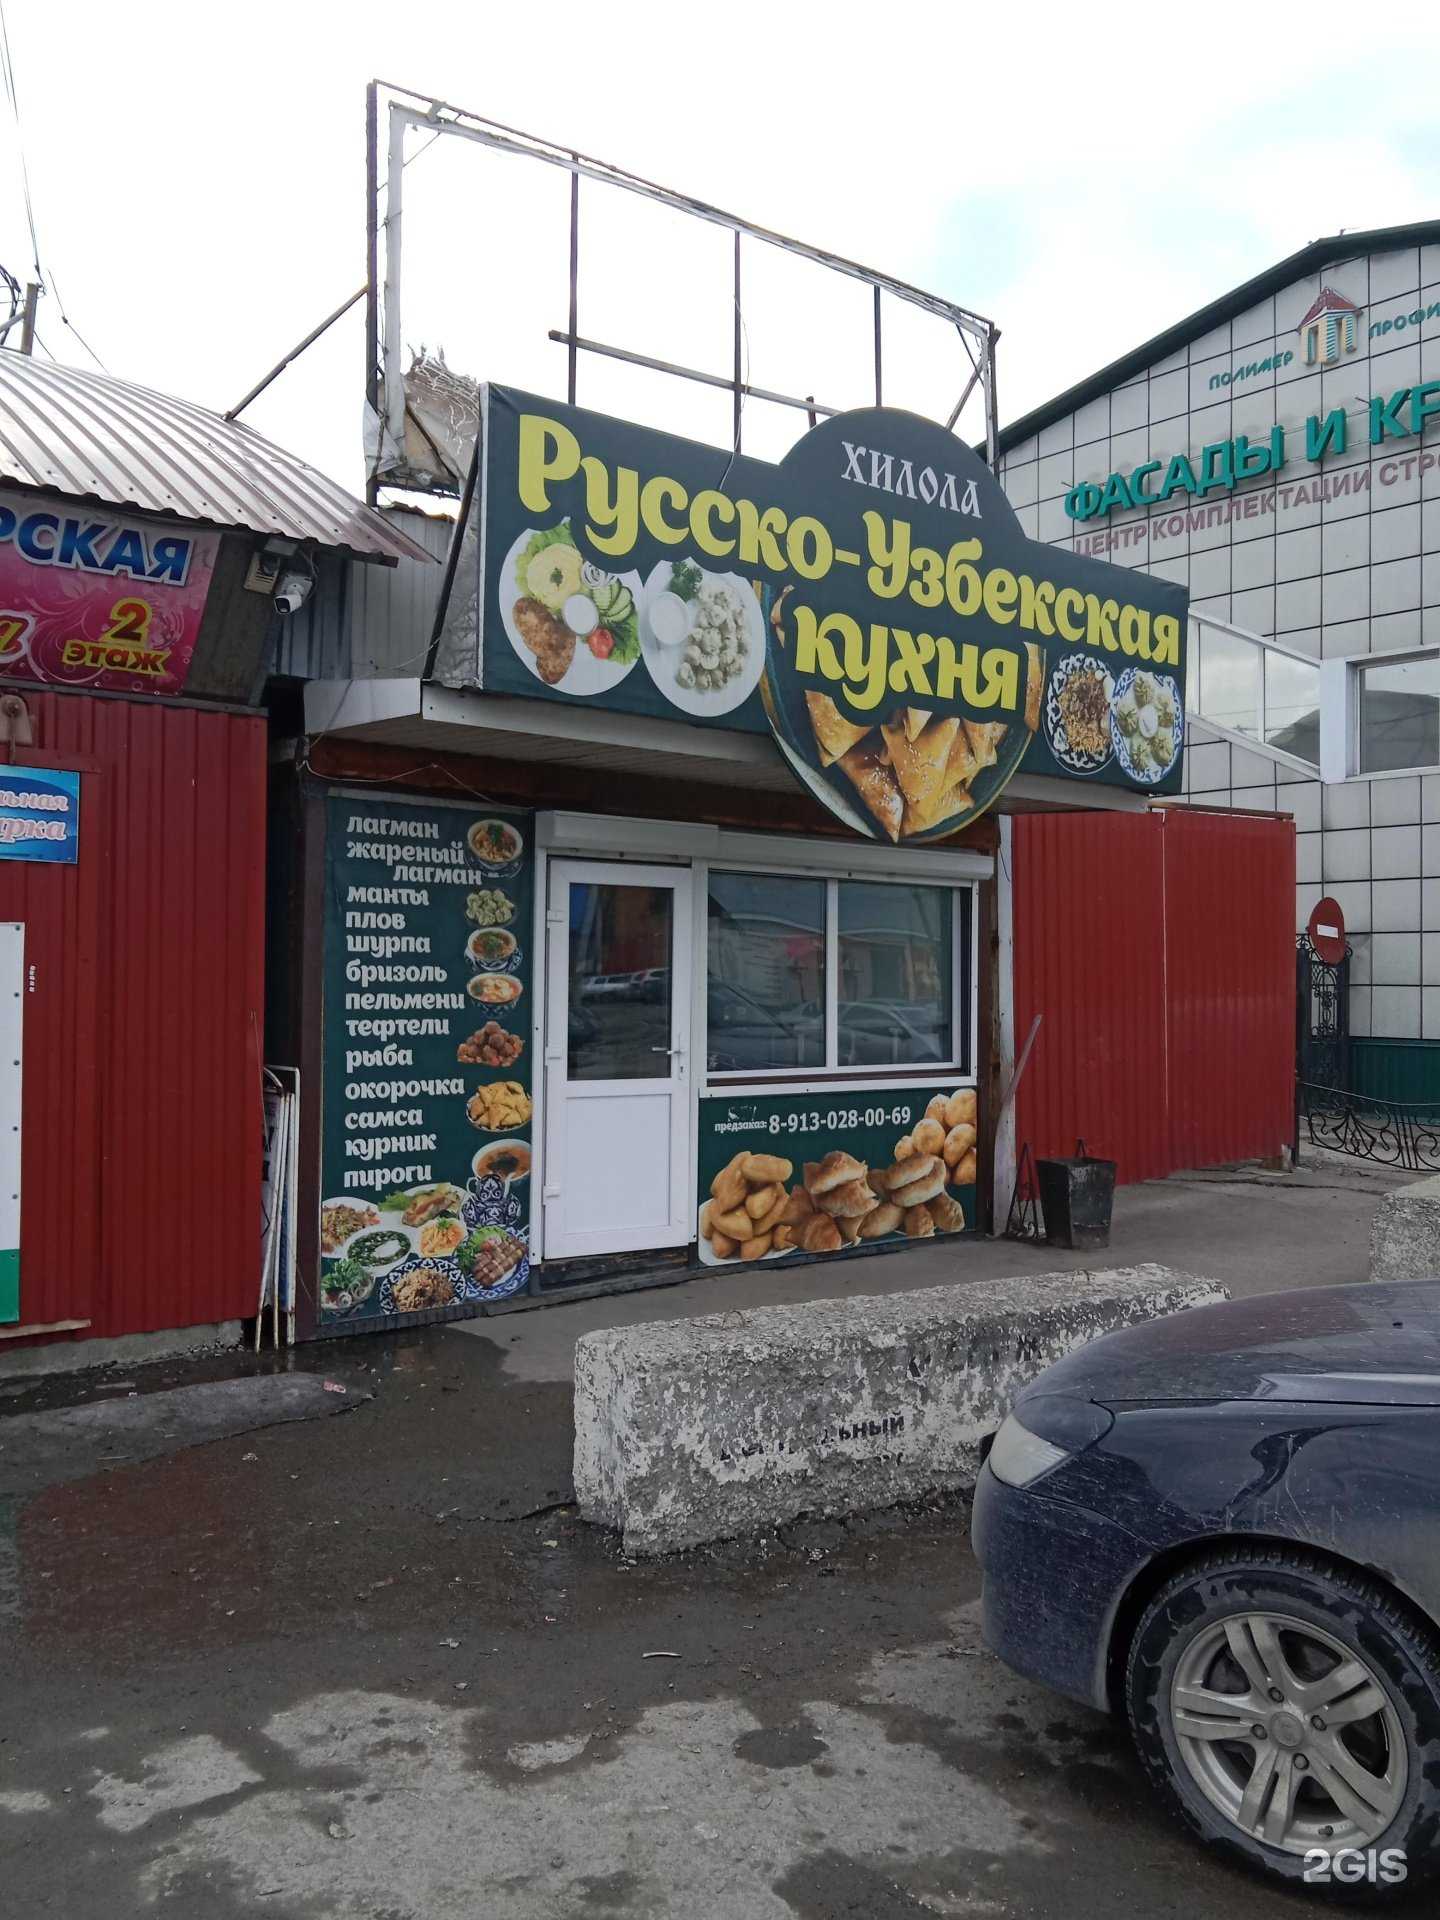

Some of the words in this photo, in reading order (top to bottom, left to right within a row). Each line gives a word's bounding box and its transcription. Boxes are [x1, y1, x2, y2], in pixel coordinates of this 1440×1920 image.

[1208, 350, 1294, 391] ПОЛИМЕР
[1064, 424, 1286, 522] ФАСАДЫ
[1305, 406, 1347, 463] И
[840, 440, 983, 519] ХИЛОЛА
[1074, 524, 1148, 556] ЦЕНТР
[1152, 468, 1371, 541] КОМПЛЕКТАЦИИ
[1379, 452, 1440, 487] СТР
[109, 600, 149, 643] 2
[346, 816, 440, 839] лагман
[346, 841, 466, 866] жареный
[393, 864, 483, 885] лагман
[346, 886, 430, 906] манты
[345, 911, 407, 930] плов
[346, 934, 431, 958] шурпа
[345, 959, 448, 988] бризоль
[345, 993, 466, 1010] пельмени
[345, 1018, 450, 1042] тефтели
[345, 1043, 413, 1073] рыба
[345, 1078, 466, 1103] окорочка
[345, 1109, 424, 1130] самса
[714, 1119, 768, 1134] предзаказ:
[768, 1106, 911, 1134] 8-913-028-00-69
[345, 1133, 438, 1161] курник
[344, 1165, 433, 1191] пироги
